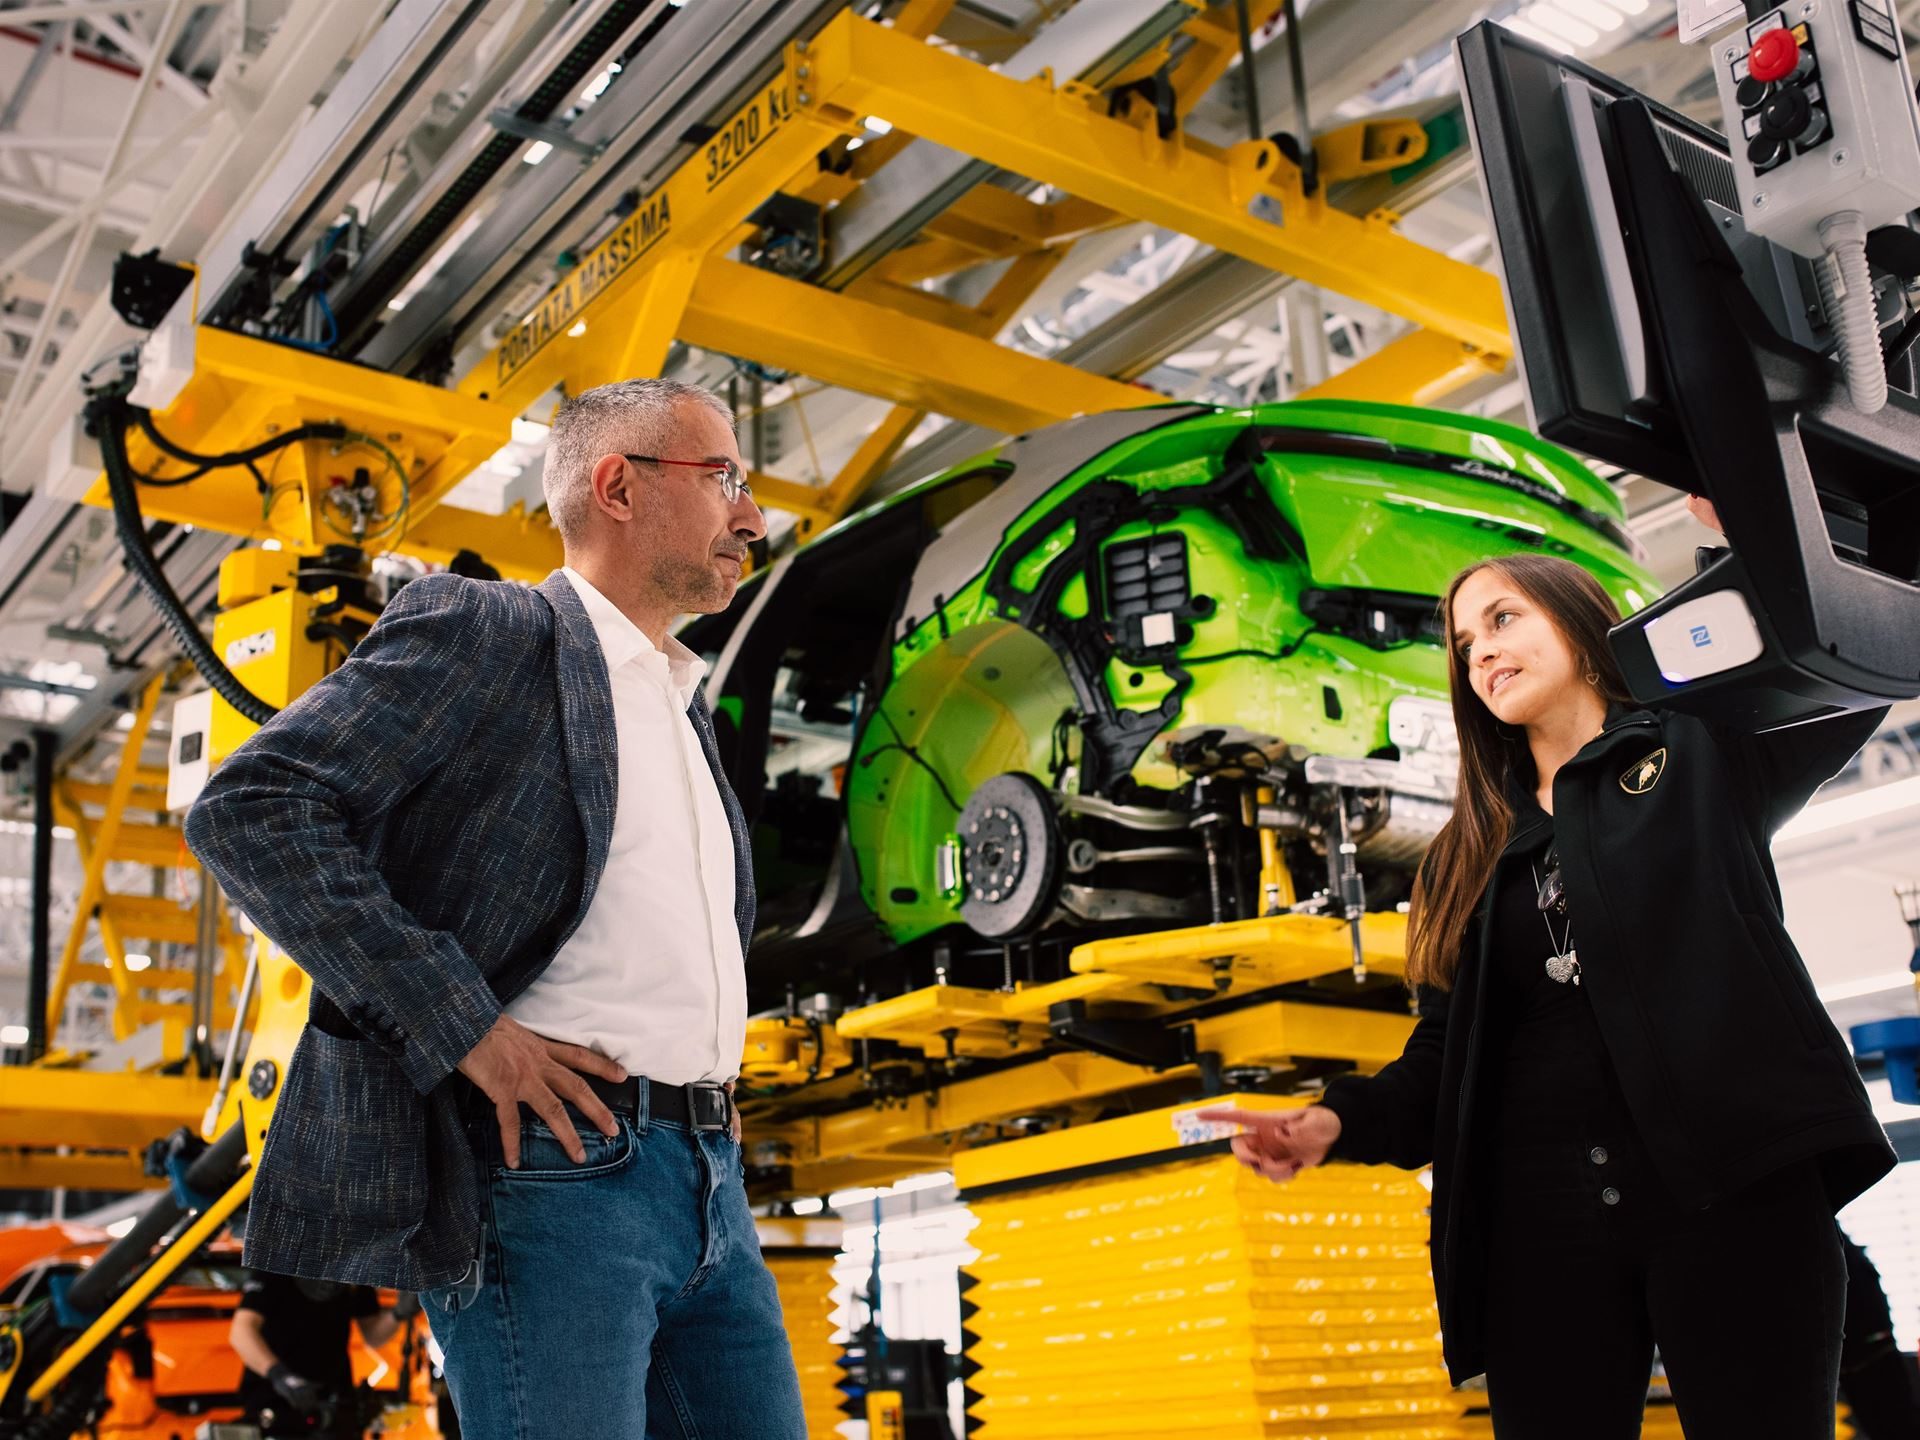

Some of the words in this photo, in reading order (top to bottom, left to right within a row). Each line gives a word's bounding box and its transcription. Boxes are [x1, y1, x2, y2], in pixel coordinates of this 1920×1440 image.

[498, 284, 574, 380] PORTATA
[580, 191, 671, 302] MASSIMA
[707, 105, 760, 182] 3200
